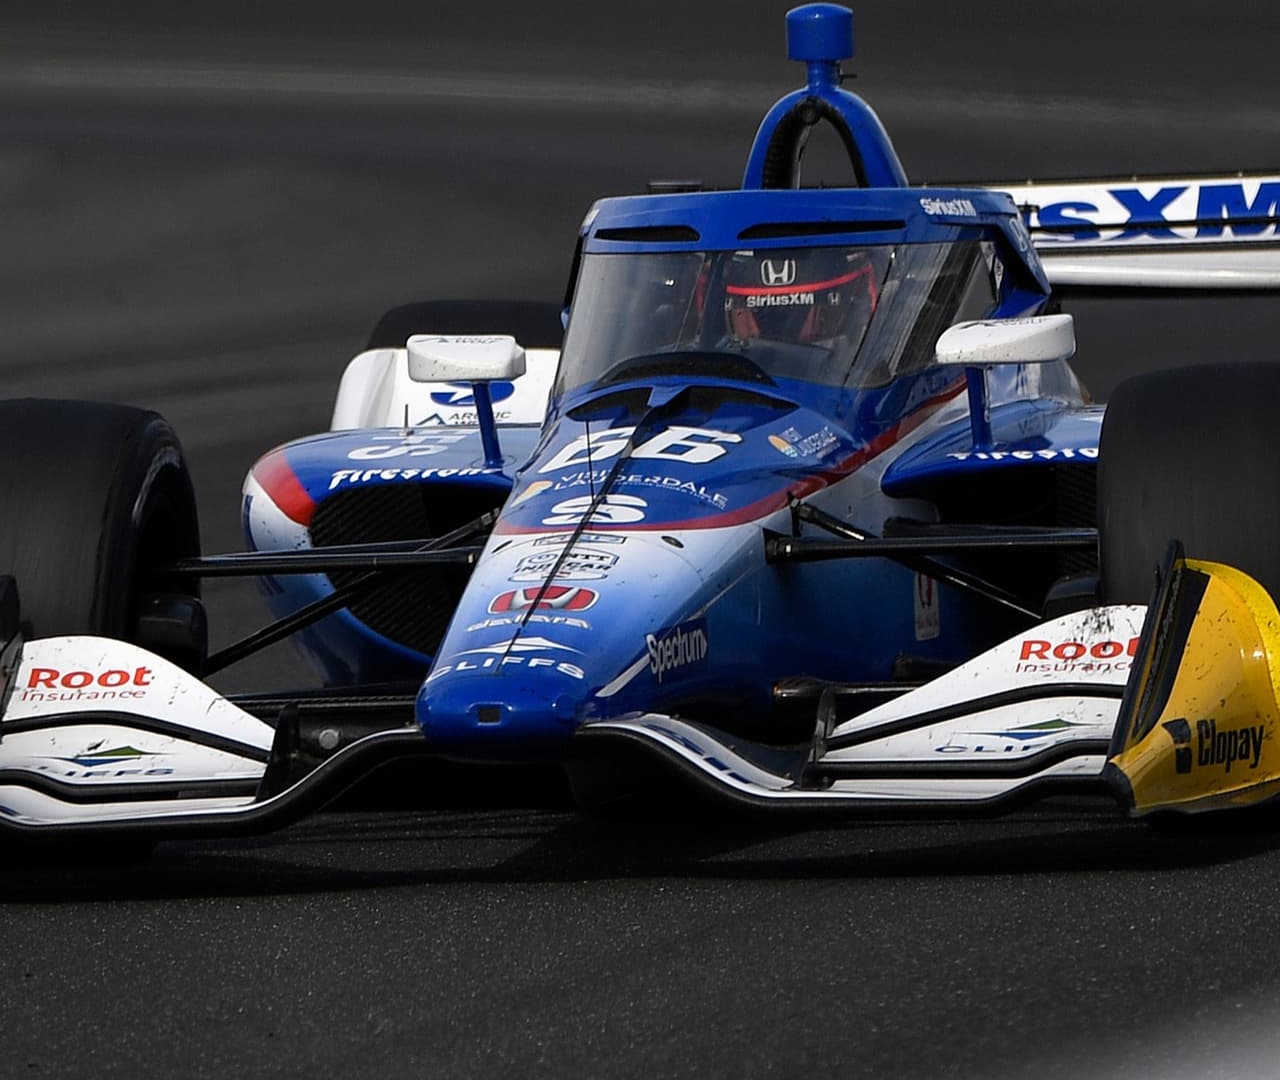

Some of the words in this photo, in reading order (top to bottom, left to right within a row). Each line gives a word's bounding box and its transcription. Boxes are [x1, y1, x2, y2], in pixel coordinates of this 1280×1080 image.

[920, 198, 977, 217] SiriusXM
[746, 291, 815, 308] SiriusXM
[538, 426, 742, 473] 66
[646, 626, 708, 684] Spectrum
[27, 666, 152, 689] Root
[424, 656, 585, 683] CLIFFS
[21, 690, 147, 702] Insurance
[1197, 719, 1264, 773] Clopay
